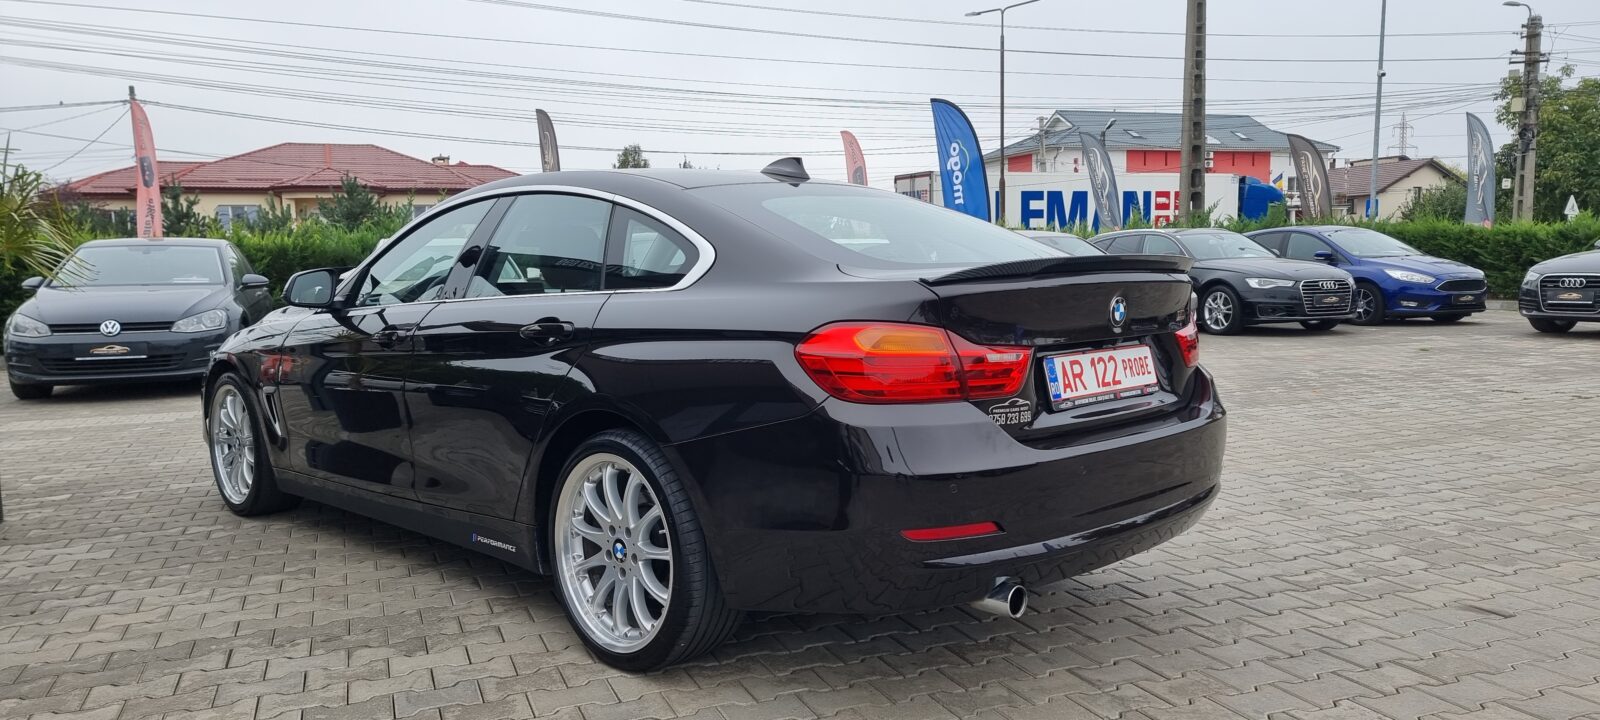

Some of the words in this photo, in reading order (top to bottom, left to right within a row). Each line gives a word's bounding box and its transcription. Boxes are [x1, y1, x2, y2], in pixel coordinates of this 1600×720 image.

[995, 191, 1151, 231] EMN
[1061, 359, 1088, 394] AR
[1090, 355, 1122, 388] 122
[1121, 356, 1152, 378] PROBE
[1050, 382, 1060, 395] RO
[1007, 412, 1019, 424] 233
